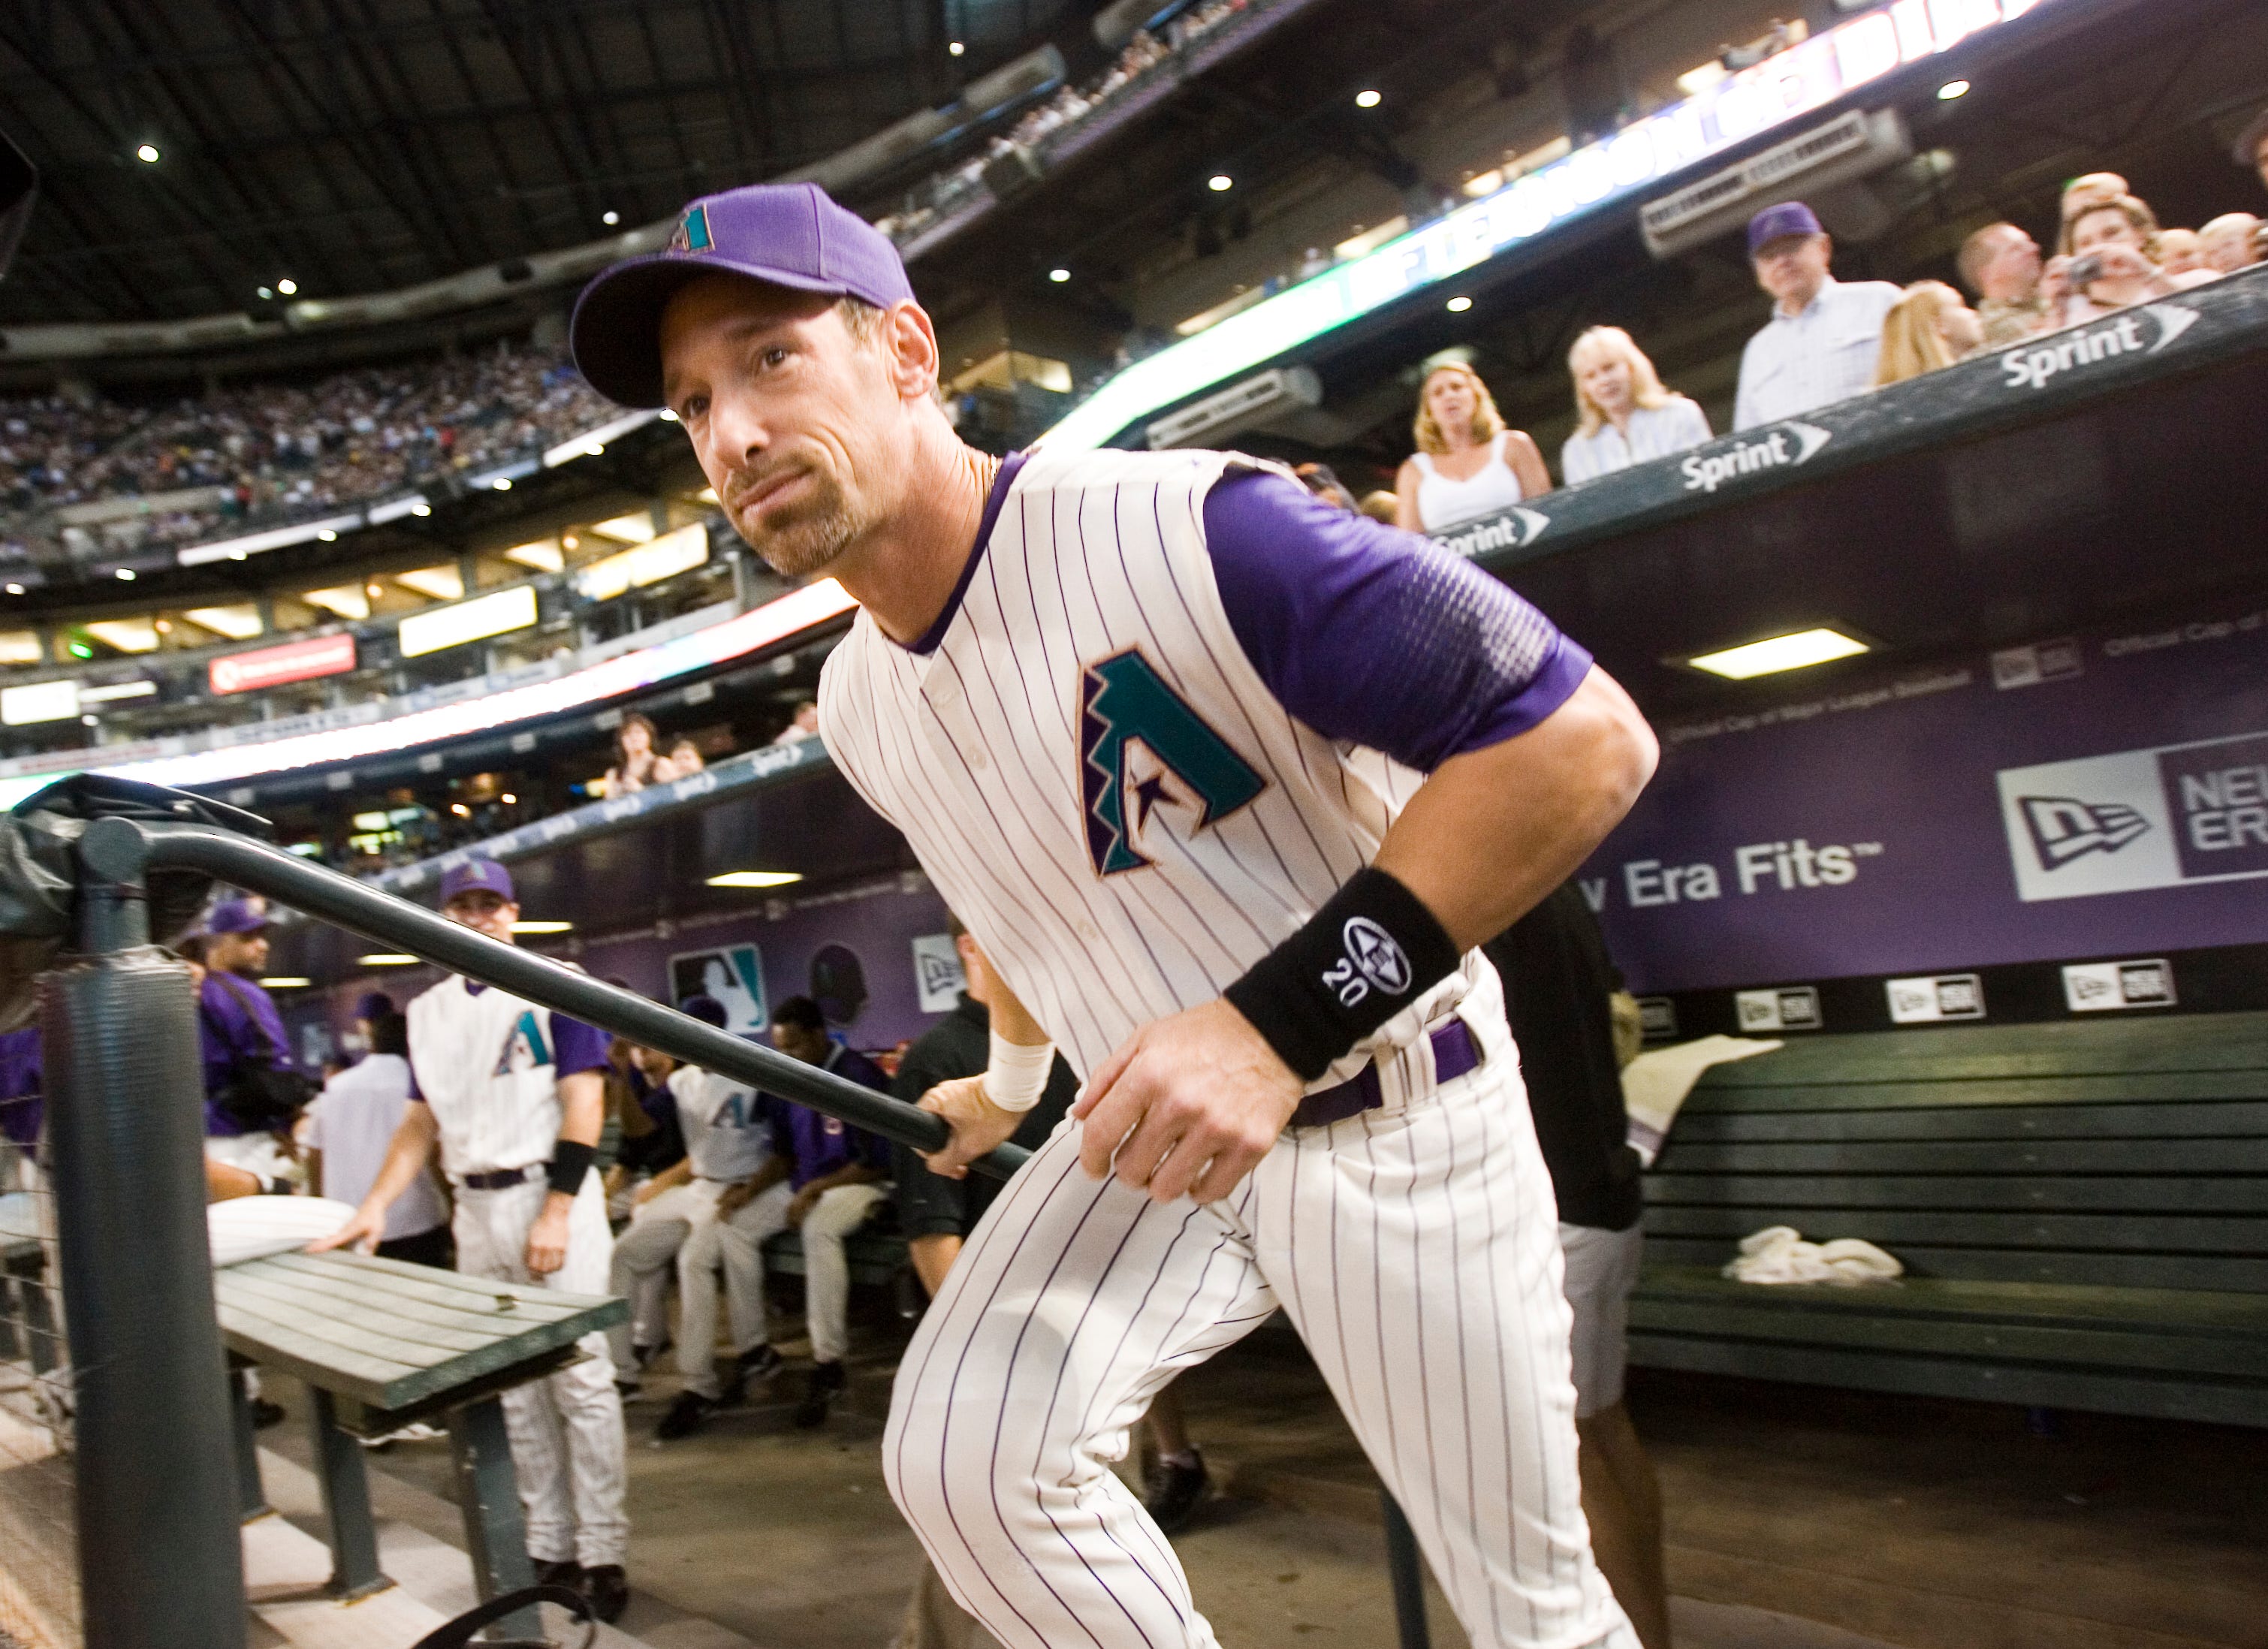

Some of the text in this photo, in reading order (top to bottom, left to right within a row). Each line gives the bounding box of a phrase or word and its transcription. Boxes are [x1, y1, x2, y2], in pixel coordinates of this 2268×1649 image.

[2001, 315, 2144, 389] Sprint
[1681, 432, 1790, 493] Sprint
[2180, 764, 2268, 811] NE
[1623, 859, 1721, 907] Era
[1322, 957, 1369, 1008] 20
